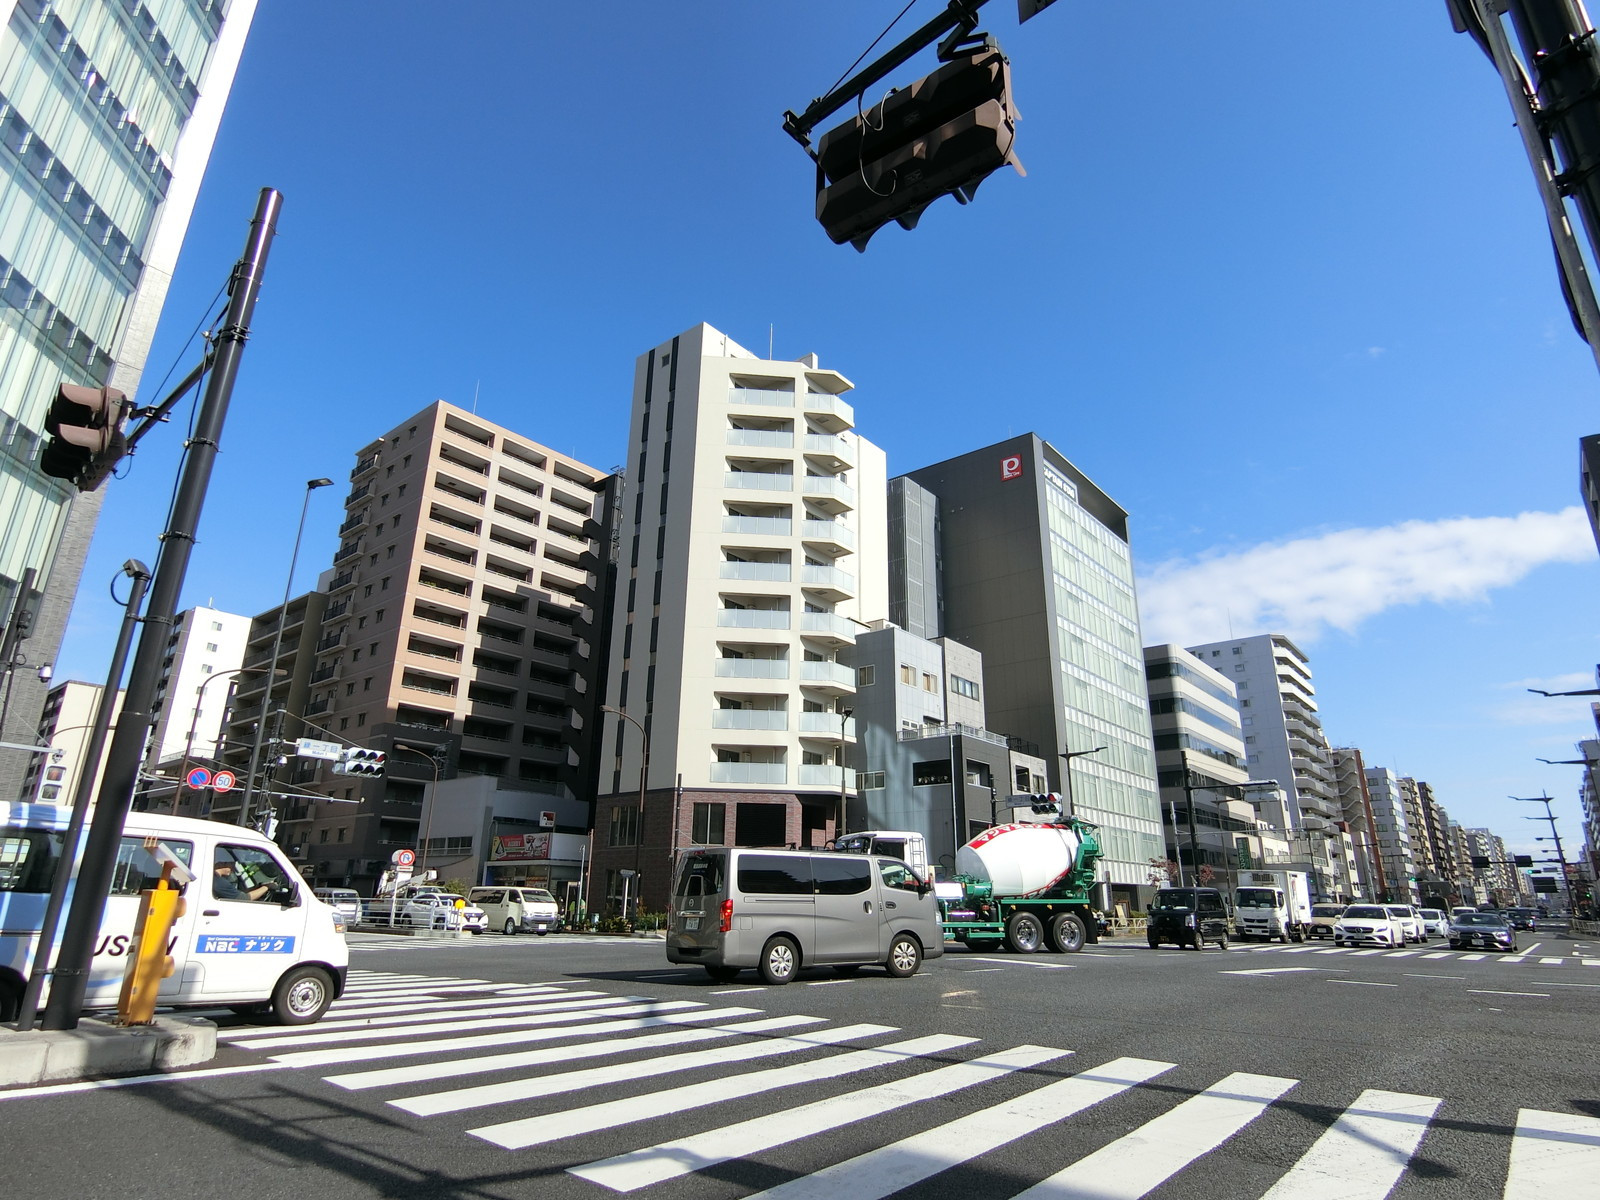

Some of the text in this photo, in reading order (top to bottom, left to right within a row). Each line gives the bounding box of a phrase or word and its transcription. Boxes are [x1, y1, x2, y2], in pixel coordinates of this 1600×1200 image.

[218, 776, 230, 786] 50
[245, 939, 285, 951] ナック
